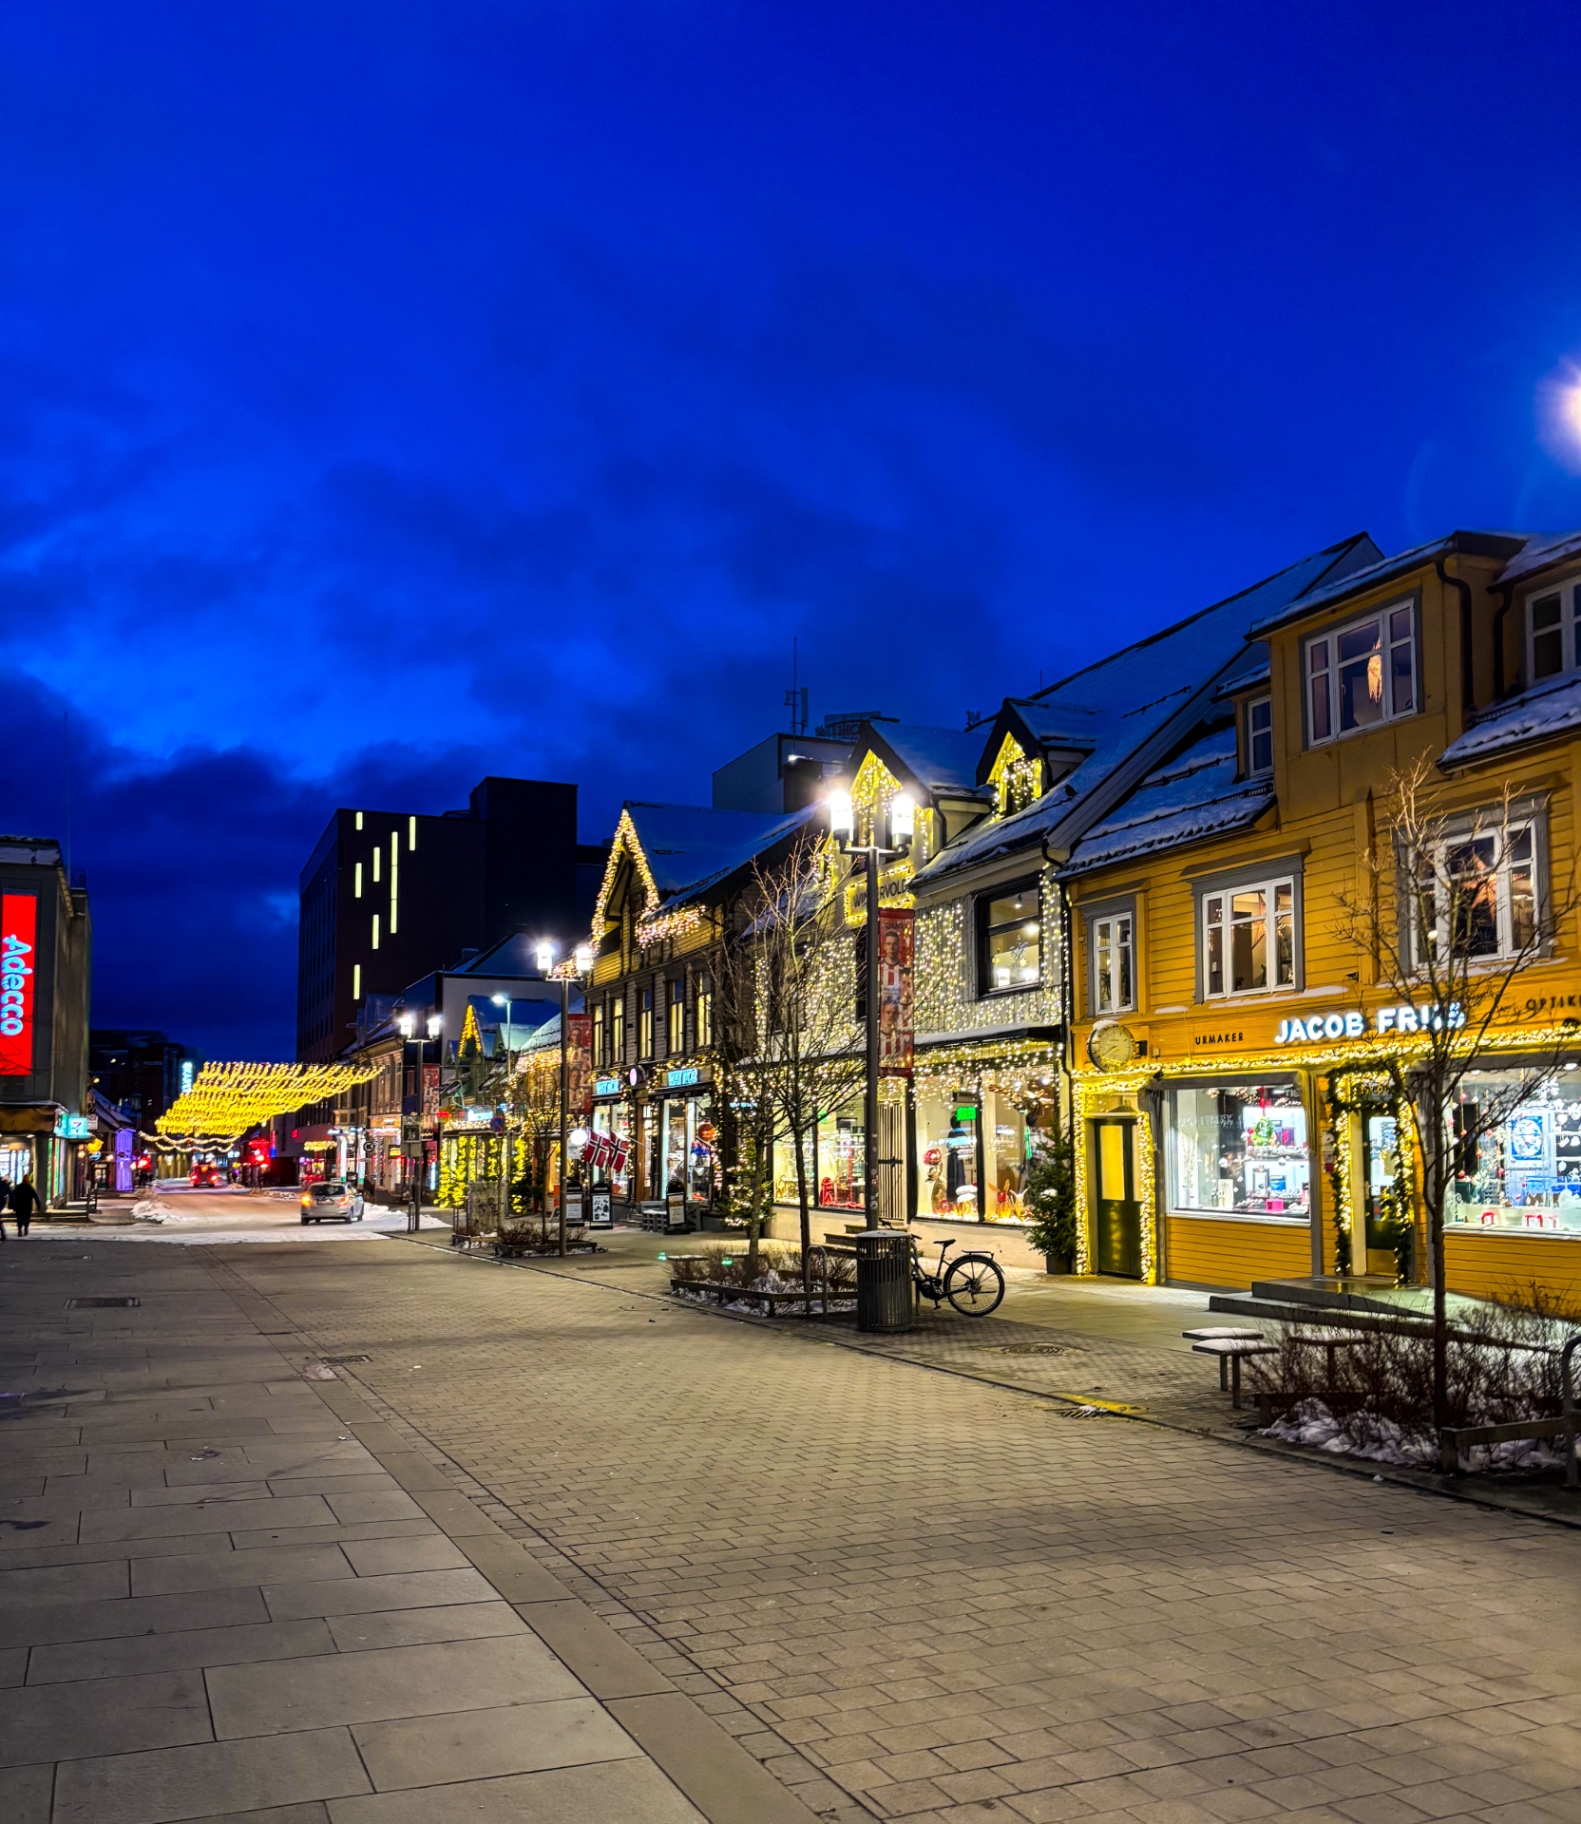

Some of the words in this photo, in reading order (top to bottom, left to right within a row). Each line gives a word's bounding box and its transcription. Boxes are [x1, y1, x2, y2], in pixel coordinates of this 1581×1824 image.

[1, 934, 33, 1036] Adecco
[1525, 993, 1581, 1011] OPTIK
[1194, 1032, 1245, 1046] URMAKER
[1274, 1012, 1364, 1044] JACOB
